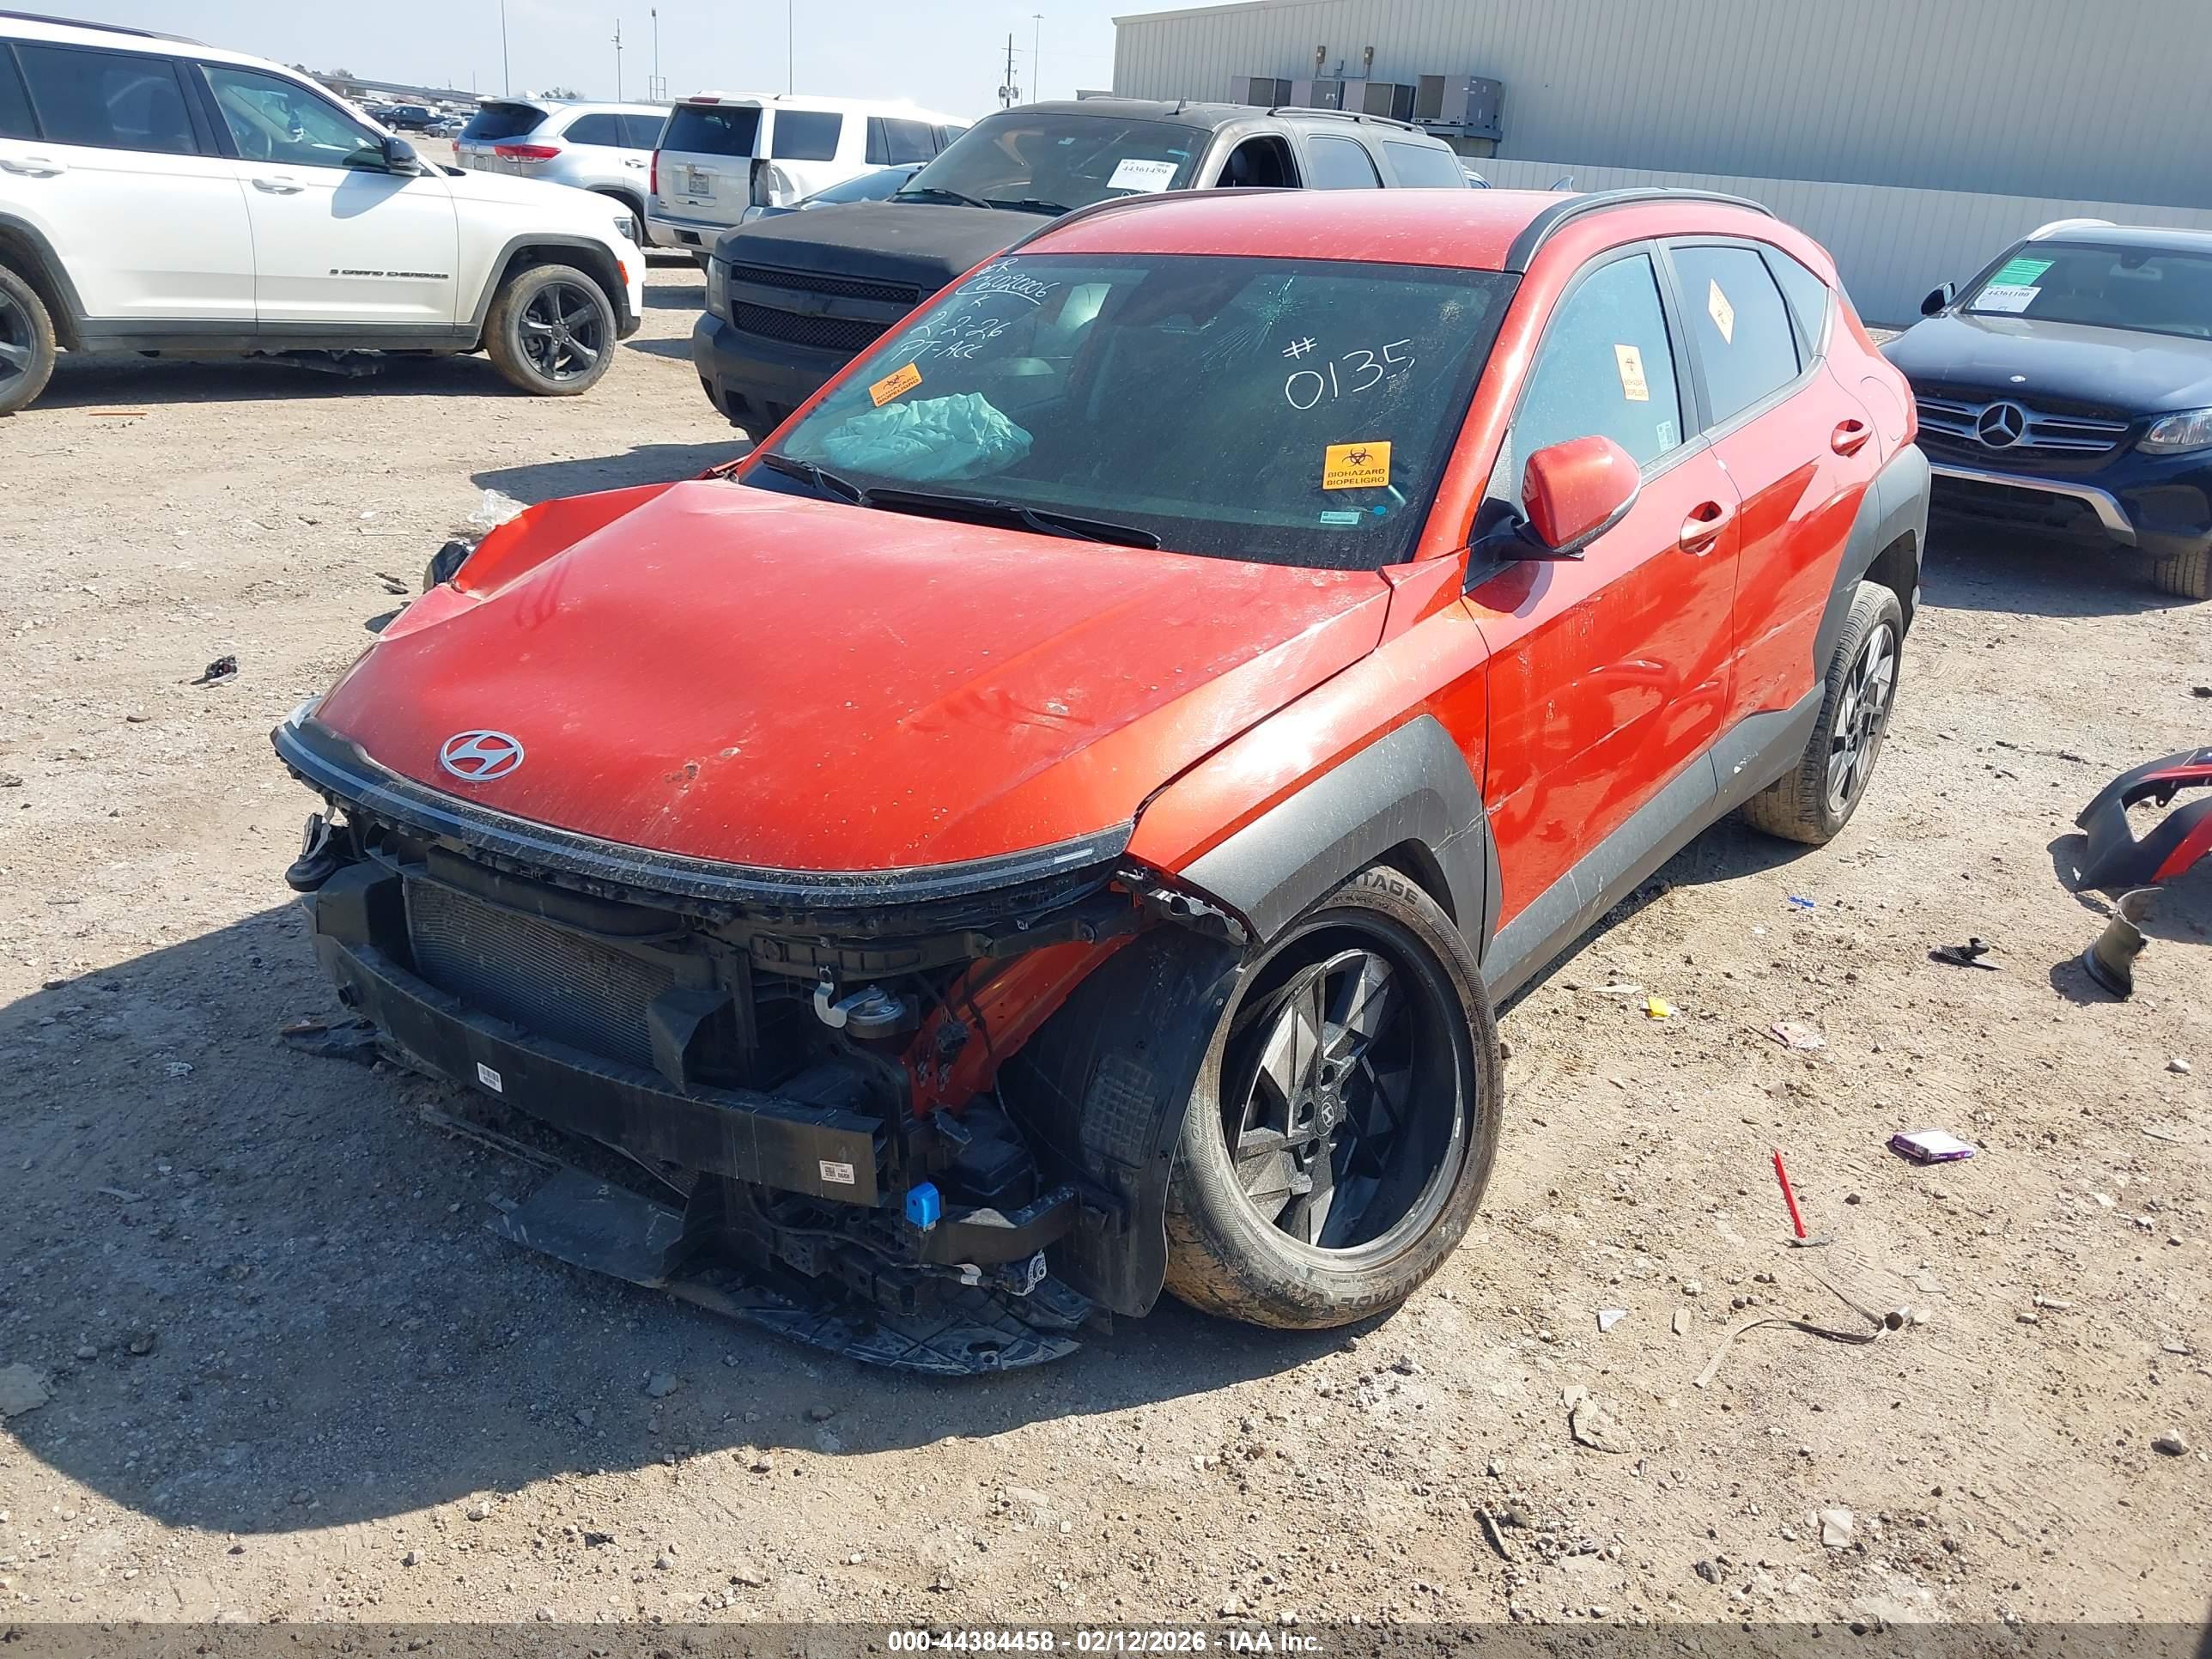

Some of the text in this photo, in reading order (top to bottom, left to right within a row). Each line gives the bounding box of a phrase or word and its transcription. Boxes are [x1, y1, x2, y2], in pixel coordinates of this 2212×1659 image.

[386, 270, 449, 279] CHEROKEE
[1285, 338, 1416, 410] 0135
[1328, 468, 1385, 478] BIOHAZARD
[1327, 477, 1385, 486] BIOPELIGRO
